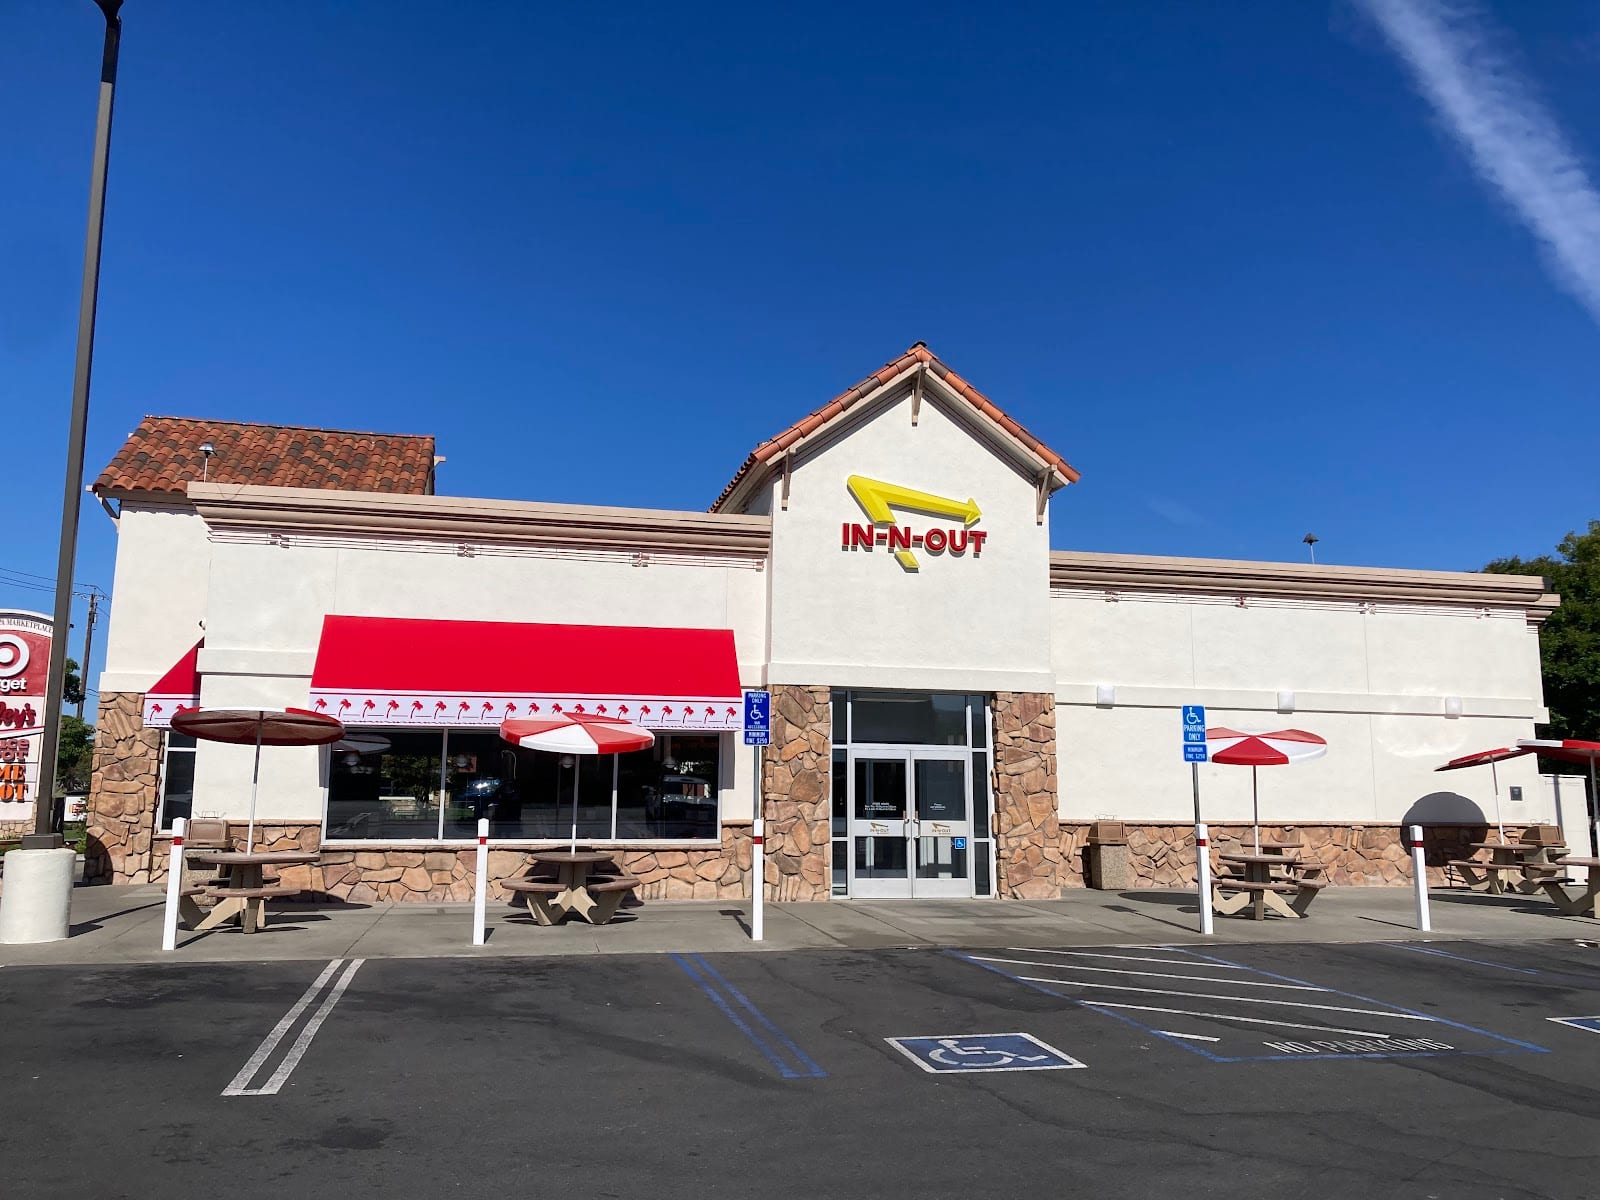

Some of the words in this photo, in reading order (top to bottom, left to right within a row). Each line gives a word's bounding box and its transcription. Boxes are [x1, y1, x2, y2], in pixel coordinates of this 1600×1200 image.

[842, 522, 987, 553] IN-N-OUT
[7, 619, 53, 633] MARKETPLACE
[0, 677, 26, 692] get
[1183, 724, 1205, 733] PARKING
[1188, 732, 1201, 741] ONLY
[1263, 1041, 1319, 1053] NO
[1310, 1038, 1455, 1053] PARKING
